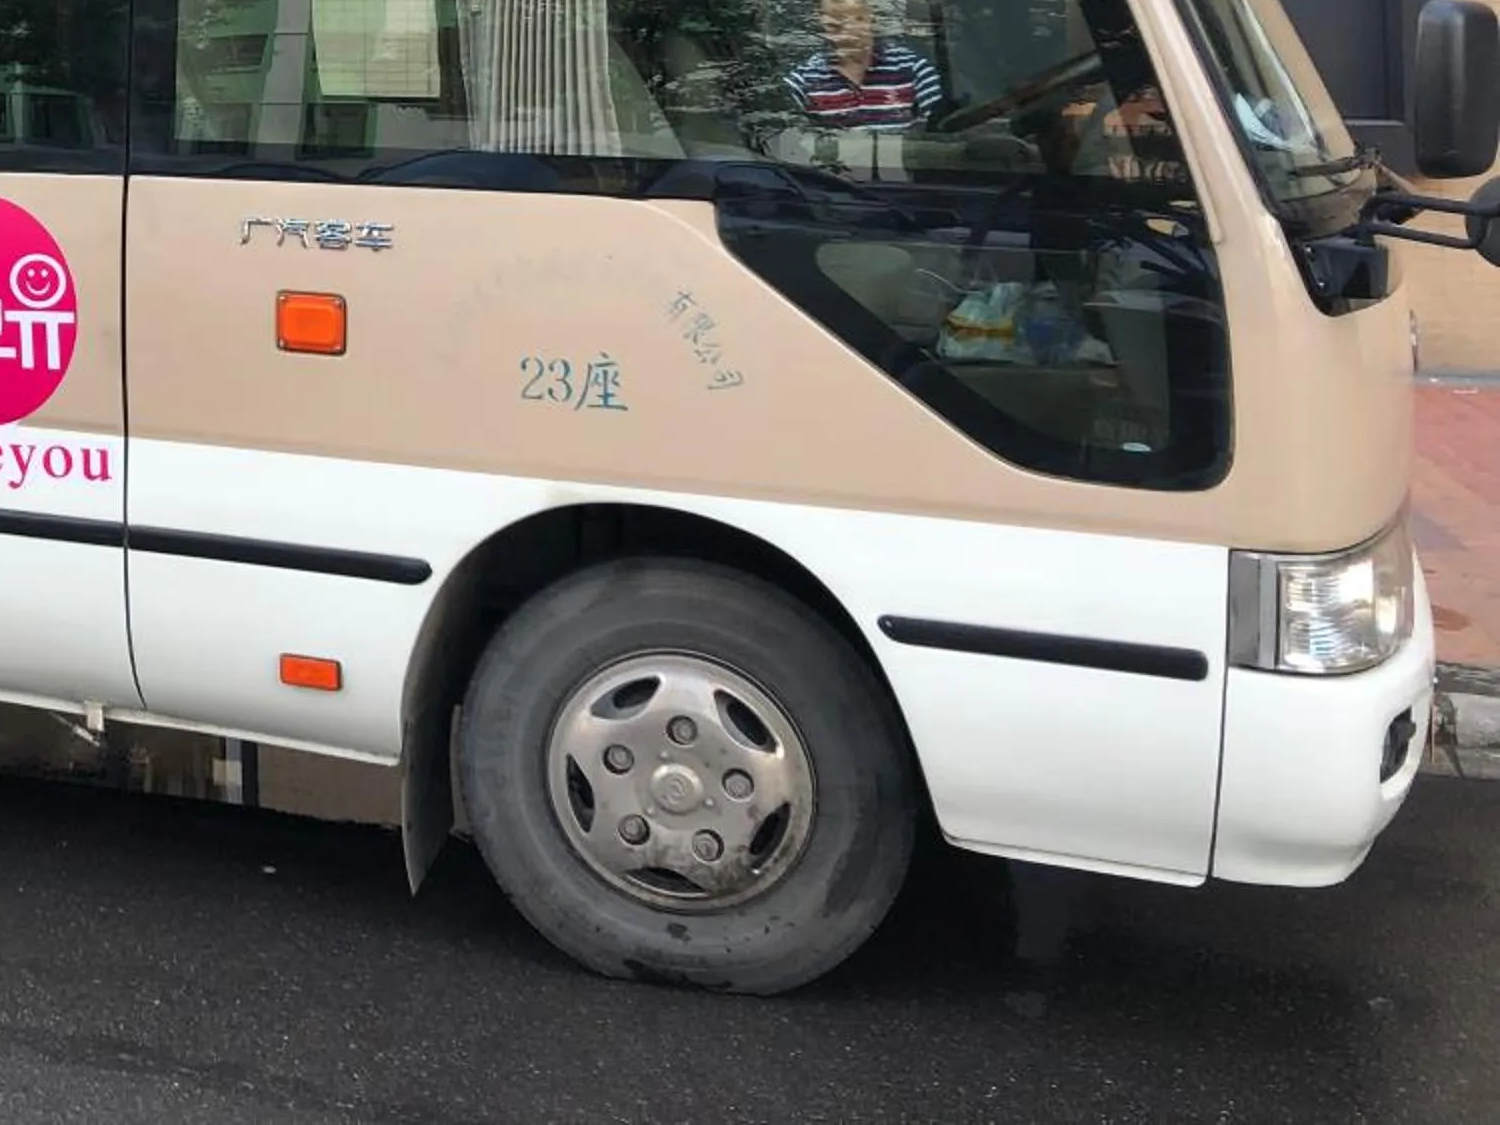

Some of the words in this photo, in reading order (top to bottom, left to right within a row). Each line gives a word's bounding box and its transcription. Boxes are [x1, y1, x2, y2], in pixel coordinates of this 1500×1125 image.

[240, 217, 394, 252] 广汽客车
[518, 351, 630, 412] 23座
